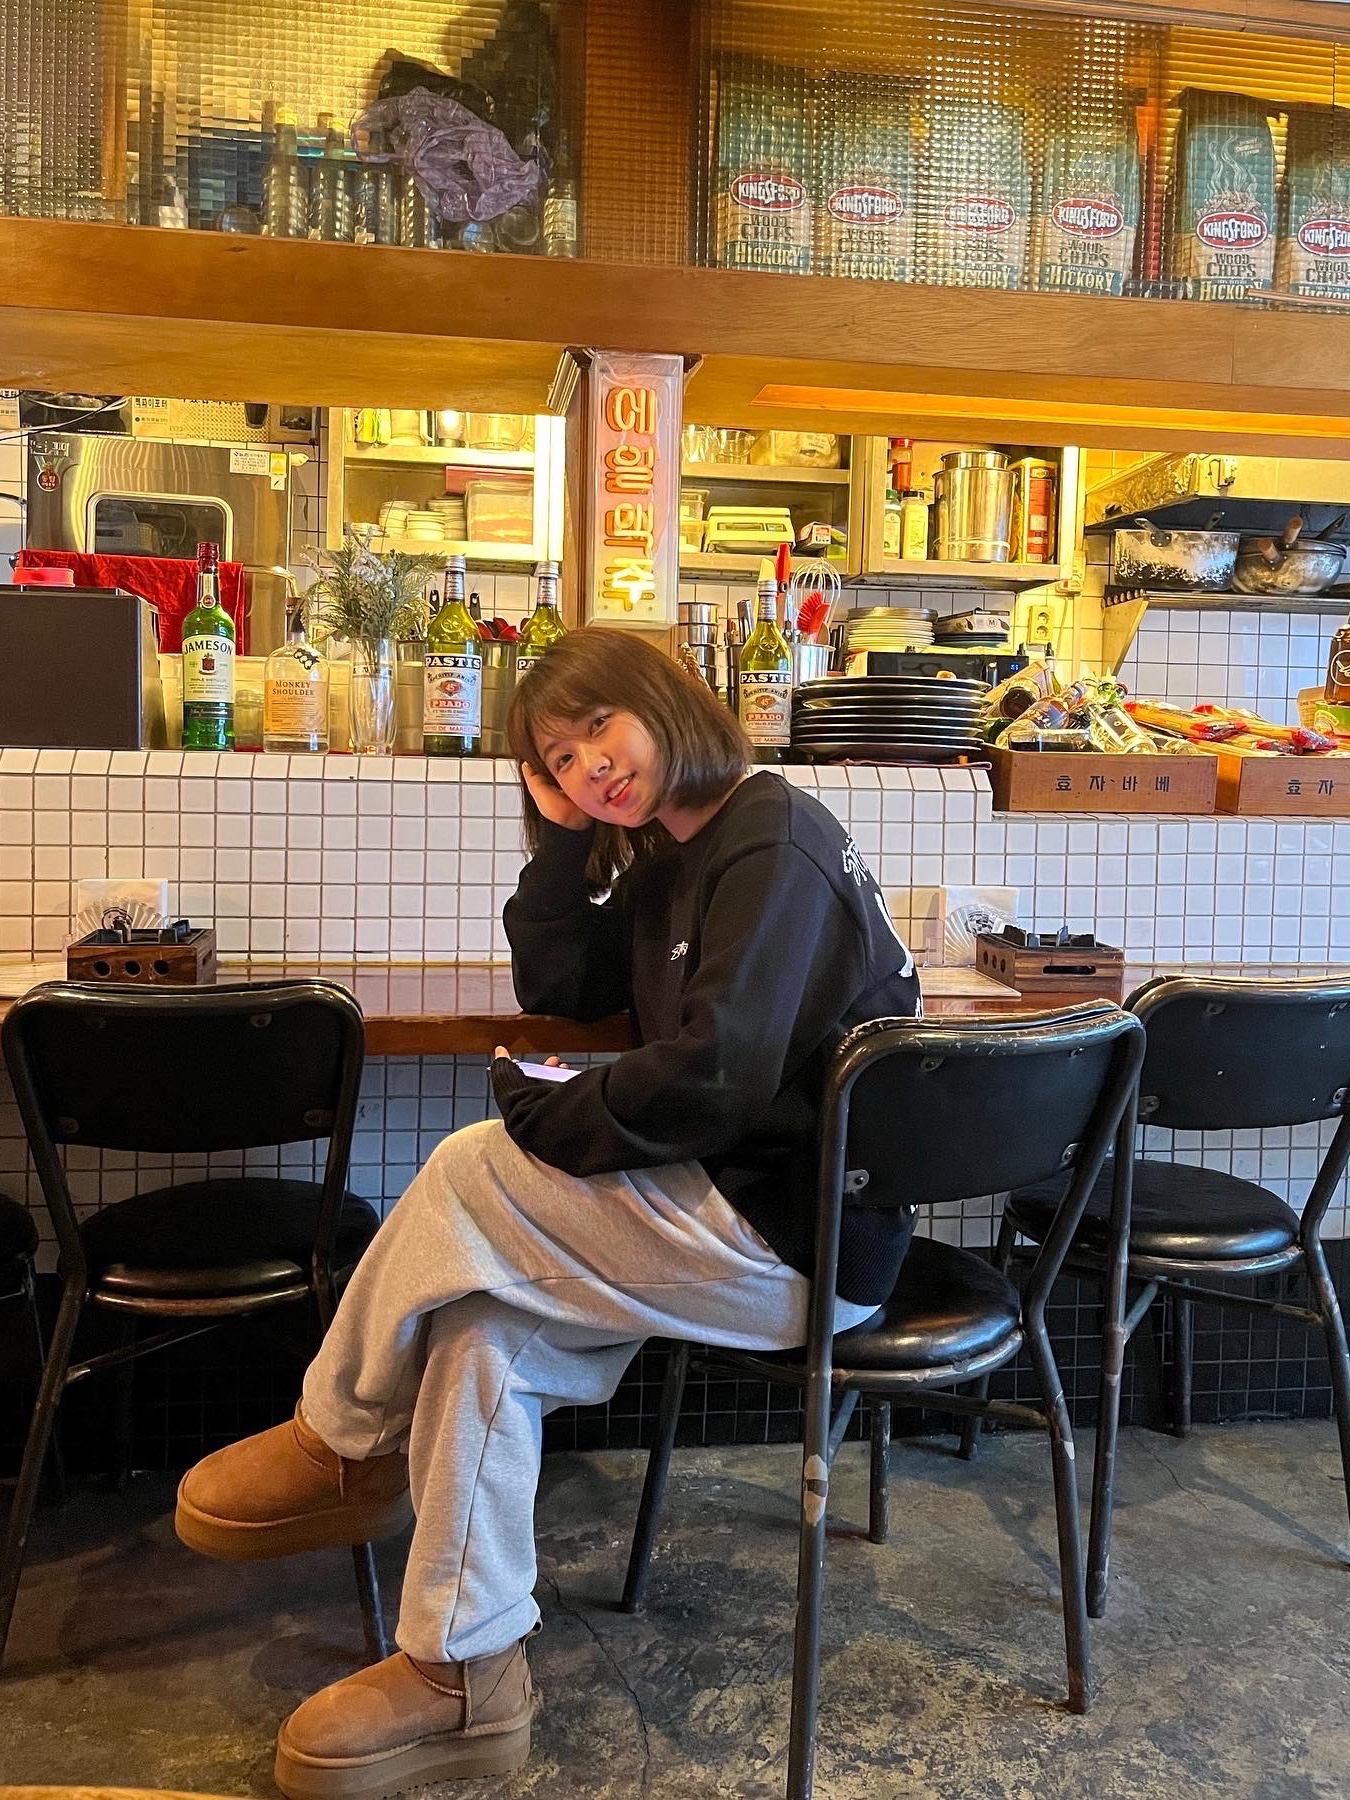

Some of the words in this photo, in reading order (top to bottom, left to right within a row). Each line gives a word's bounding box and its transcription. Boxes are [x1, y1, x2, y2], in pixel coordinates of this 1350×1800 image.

[738, 178, 800, 204] KINGSFORD
[1058, 205, 1118, 229] KINGSFORD
[1203, 218, 1262, 243] KINGSFORD
[733, 242, 801, 267] HICKORY
[1059, 247, 1110, 268] CHIPS
[1214, 253, 1251, 265] WOOD
[1048, 264, 1115, 292] HICKORY
[1206, 262, 1257, 278] CHIPS
[602, 386, 657, 612] 에일맥주
[184, 640, 233, 655] JAMESON
[425, 656, 481, 669] PASTIS
[275, 680, 311, 689] MONKEY
[741, 673, 791, 683] PASTIS
[432, 700, 470, 709] PRADO
